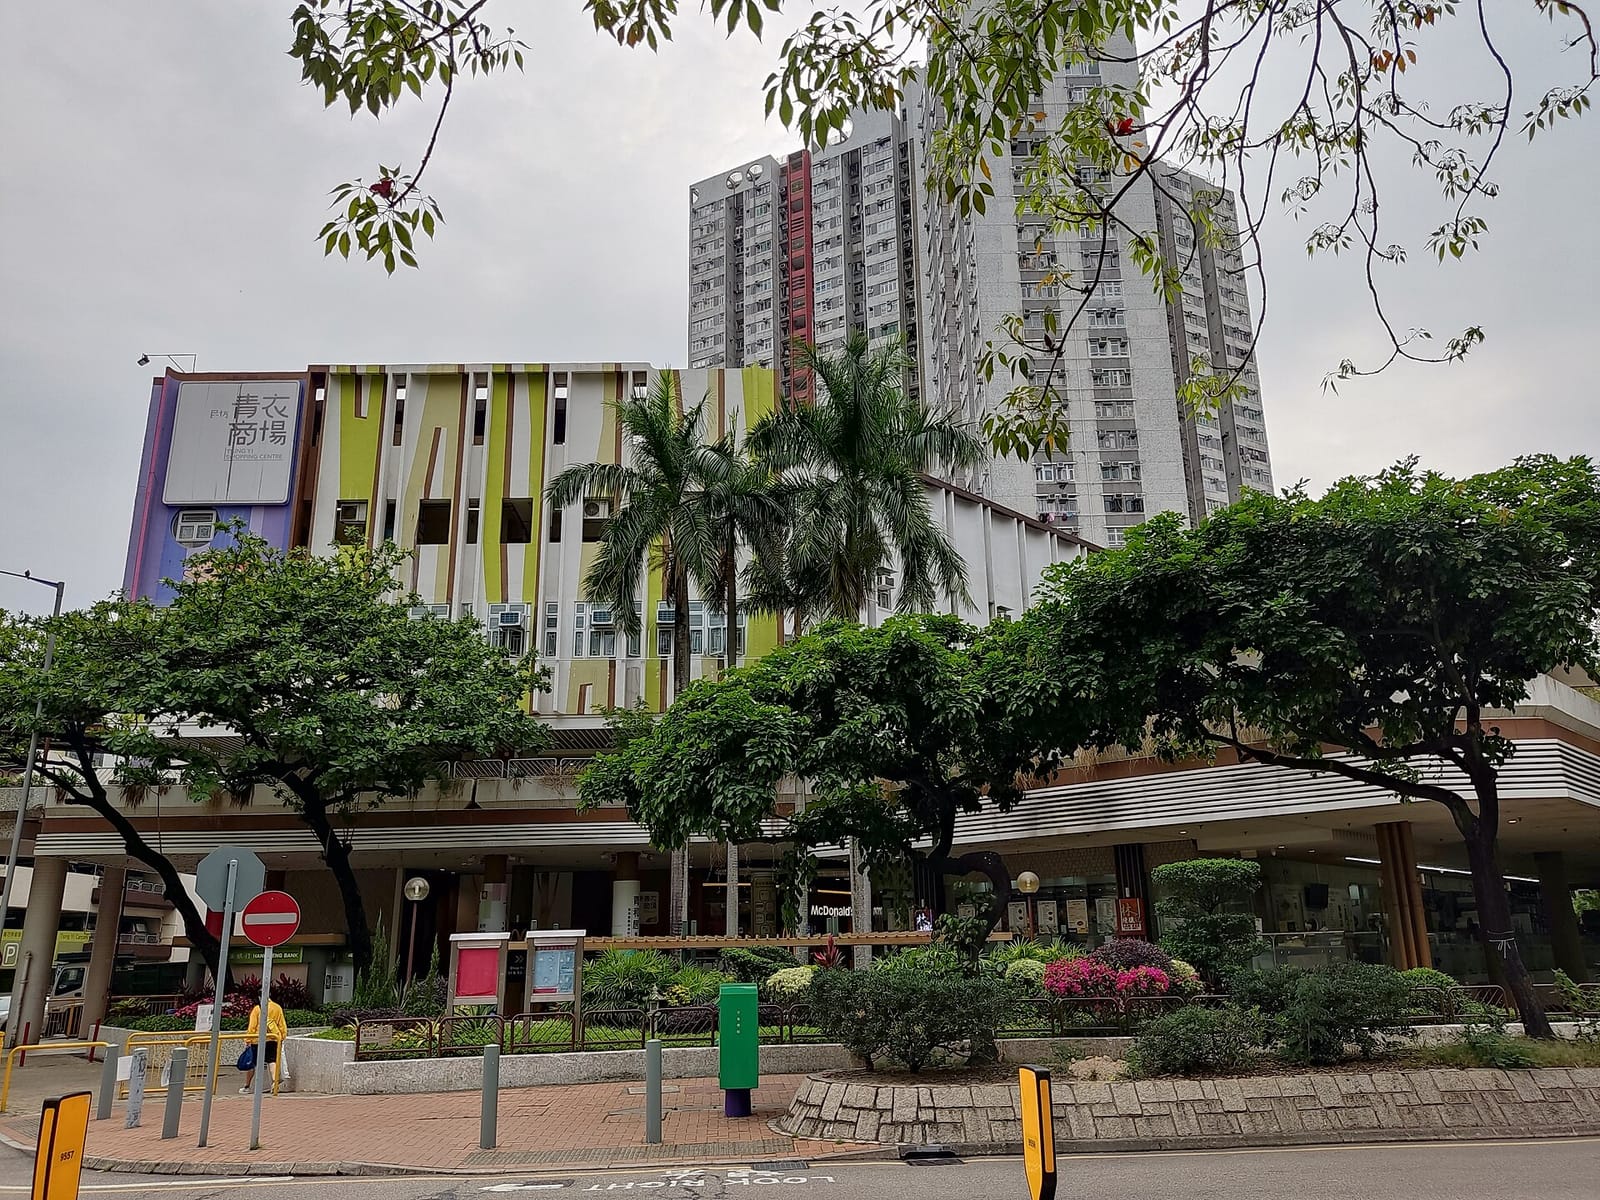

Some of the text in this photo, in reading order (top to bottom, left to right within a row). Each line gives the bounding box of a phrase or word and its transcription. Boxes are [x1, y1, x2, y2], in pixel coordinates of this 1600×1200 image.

[232, 393, 290, 419] 青衣
[228, 420, 287, 446] 商場
[582, 1176, 836, 1191] LOOK RIGHT
